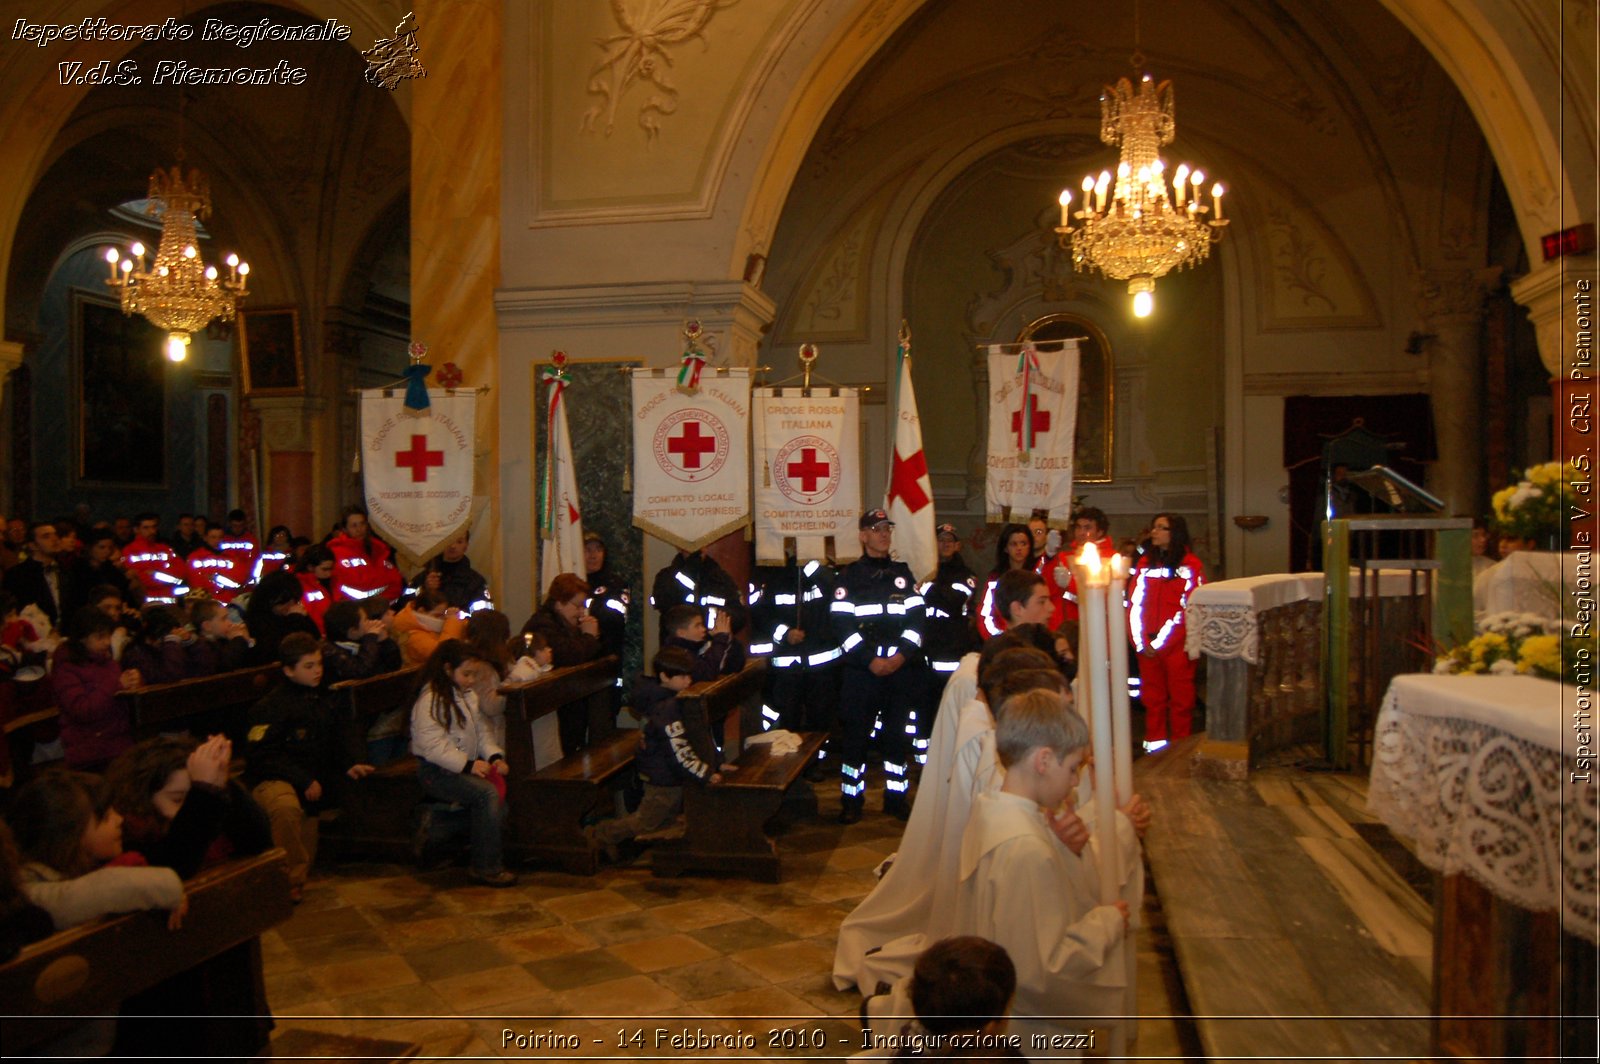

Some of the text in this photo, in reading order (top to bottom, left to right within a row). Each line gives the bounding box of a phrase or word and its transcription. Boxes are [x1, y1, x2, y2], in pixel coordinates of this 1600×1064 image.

[637, 388, 747, 420] CROCE ITALIANA
[767, 406, 846, 415] CROCE ROSSA
[781, 420, 833, 429] ITALIANA
[371, 413, 468, 452] CROCE ITALIANA
[647, 493, 736, 504] COMITATO LOCALE
[368, 497, 383, 515] SAN
[383, 512, 433, 533] FRANCESCO
[448, 495, 472, 522] CAMPO
[640, 506, 742, 518] SETTIMO TORINESE
[763, 509, 854, 519] COMITATO LOCALE
[781, 521, 837, 531] NICHELINO
